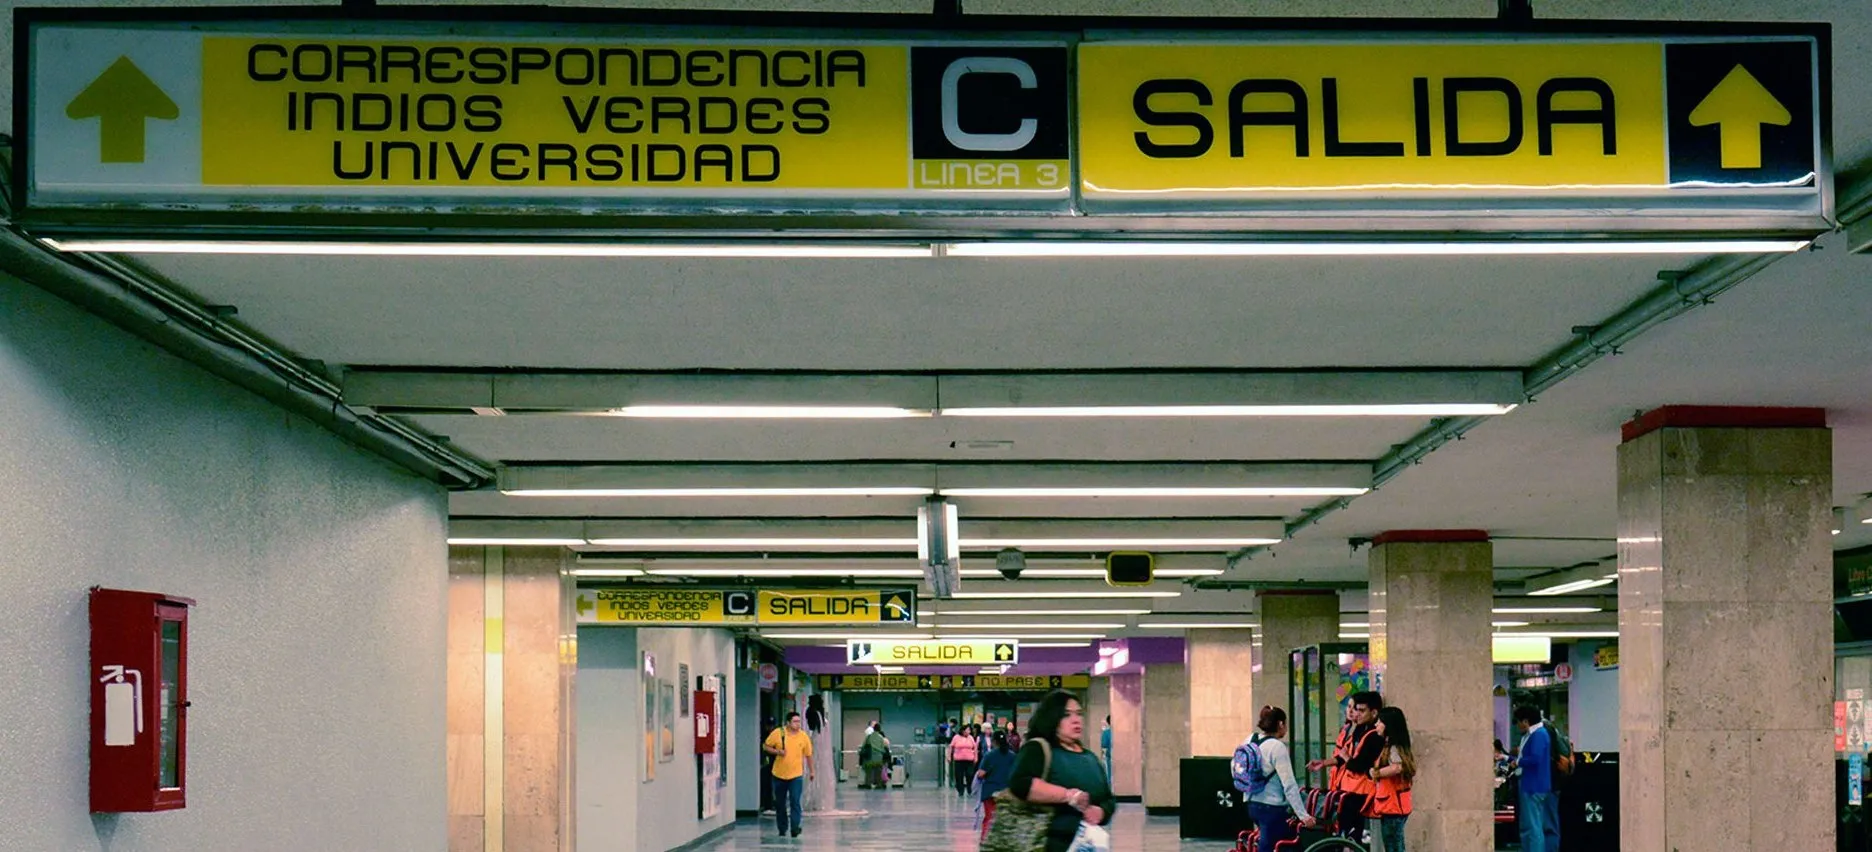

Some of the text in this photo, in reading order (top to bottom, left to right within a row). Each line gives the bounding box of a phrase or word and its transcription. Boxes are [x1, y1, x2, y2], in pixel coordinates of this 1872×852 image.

[247, 44, 866, 88] CORRESPONDENCIA
[287, 92, 830, 134] INDIOS VERDES
[941, 56, 1038, 152] C
[1133, 77, 1617, 158] SALIDA
[333, 140, 781, 182] UNIVERSIDAD
[920, 161, 1059, 188] LINEA 3
[597, 591, 722, 601] CORRESPONDENCIA
[610, 601, 709, 610] INDIOS VERDES
[728, 593, 749, 614] C
[618, 611, 701, 621] UNIVERSIDAD
[770, 597, 870, 616] SALIDA
[893, 645, 973, 659] SALIDA
[853, 677, 908, 686] SALIDA
[981, 676, 1044, 687] NO PASE
